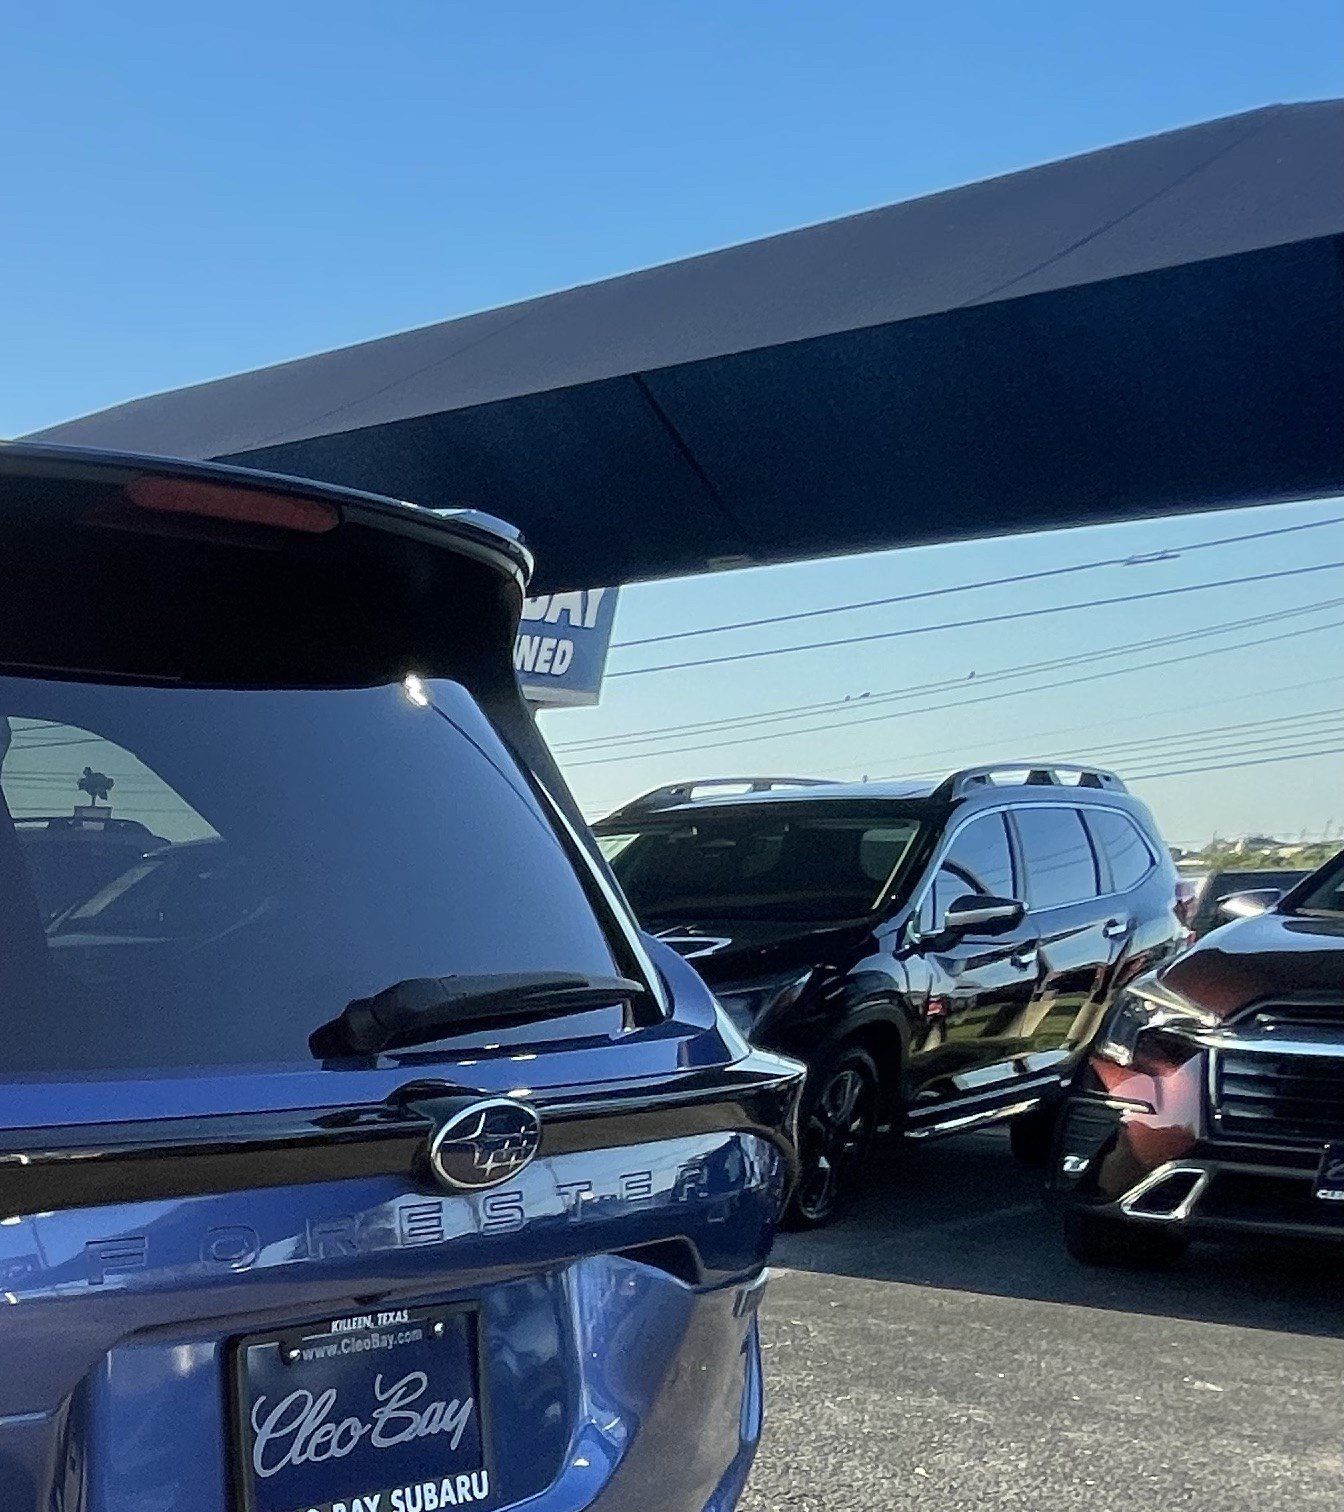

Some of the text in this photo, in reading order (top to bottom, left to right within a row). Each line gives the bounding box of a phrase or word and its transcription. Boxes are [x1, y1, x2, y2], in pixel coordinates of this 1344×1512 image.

[86, 1162, 710, 1287] FORESTER
[302, 1328, 423, 1361] www.CleoBay.com
[331, 1309, 409, 1333] KILLEEN, TEXAS
[251, 1371, 474, 1478] Cleo Bay
